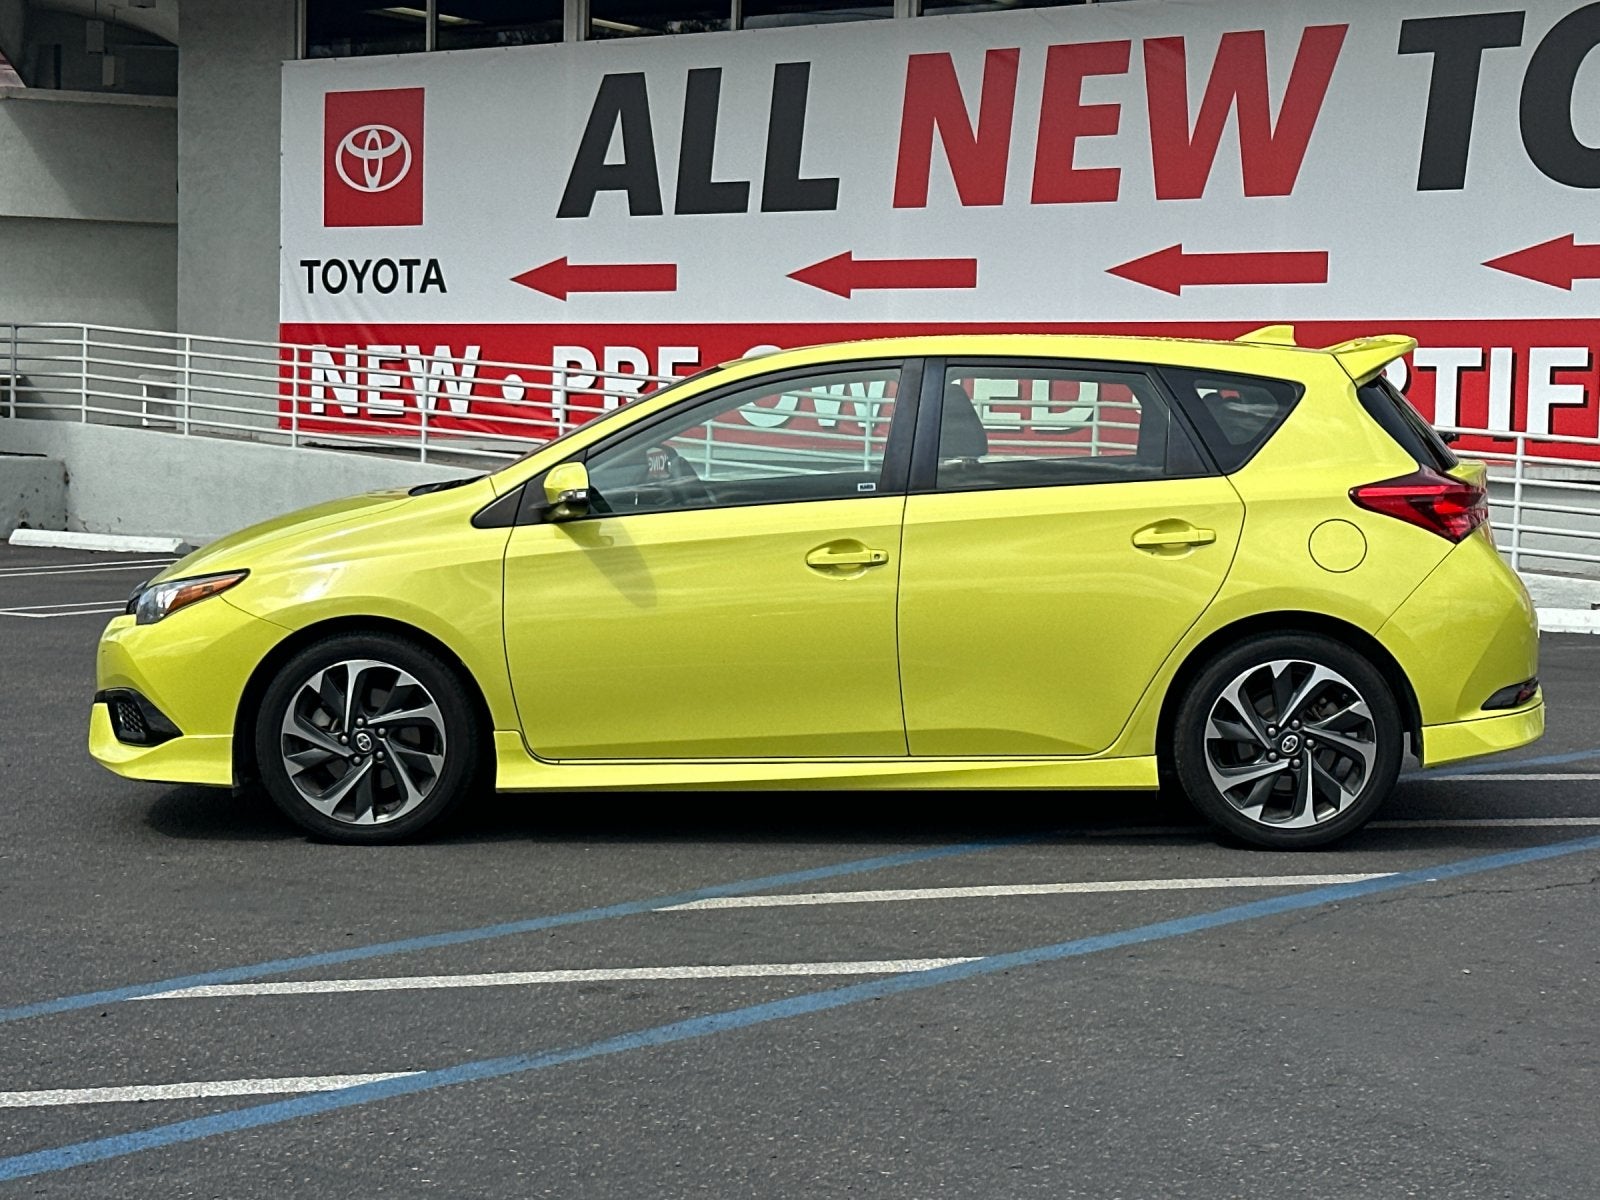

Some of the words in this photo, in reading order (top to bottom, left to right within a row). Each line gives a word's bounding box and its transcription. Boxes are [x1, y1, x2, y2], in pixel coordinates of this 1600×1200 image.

[556, 62, 841, 218] ALL
[893, 24, 1350, 209] NEW
[300, 257, 448, 295] TOYOTA
[310, 344, 480, 416] NEW
